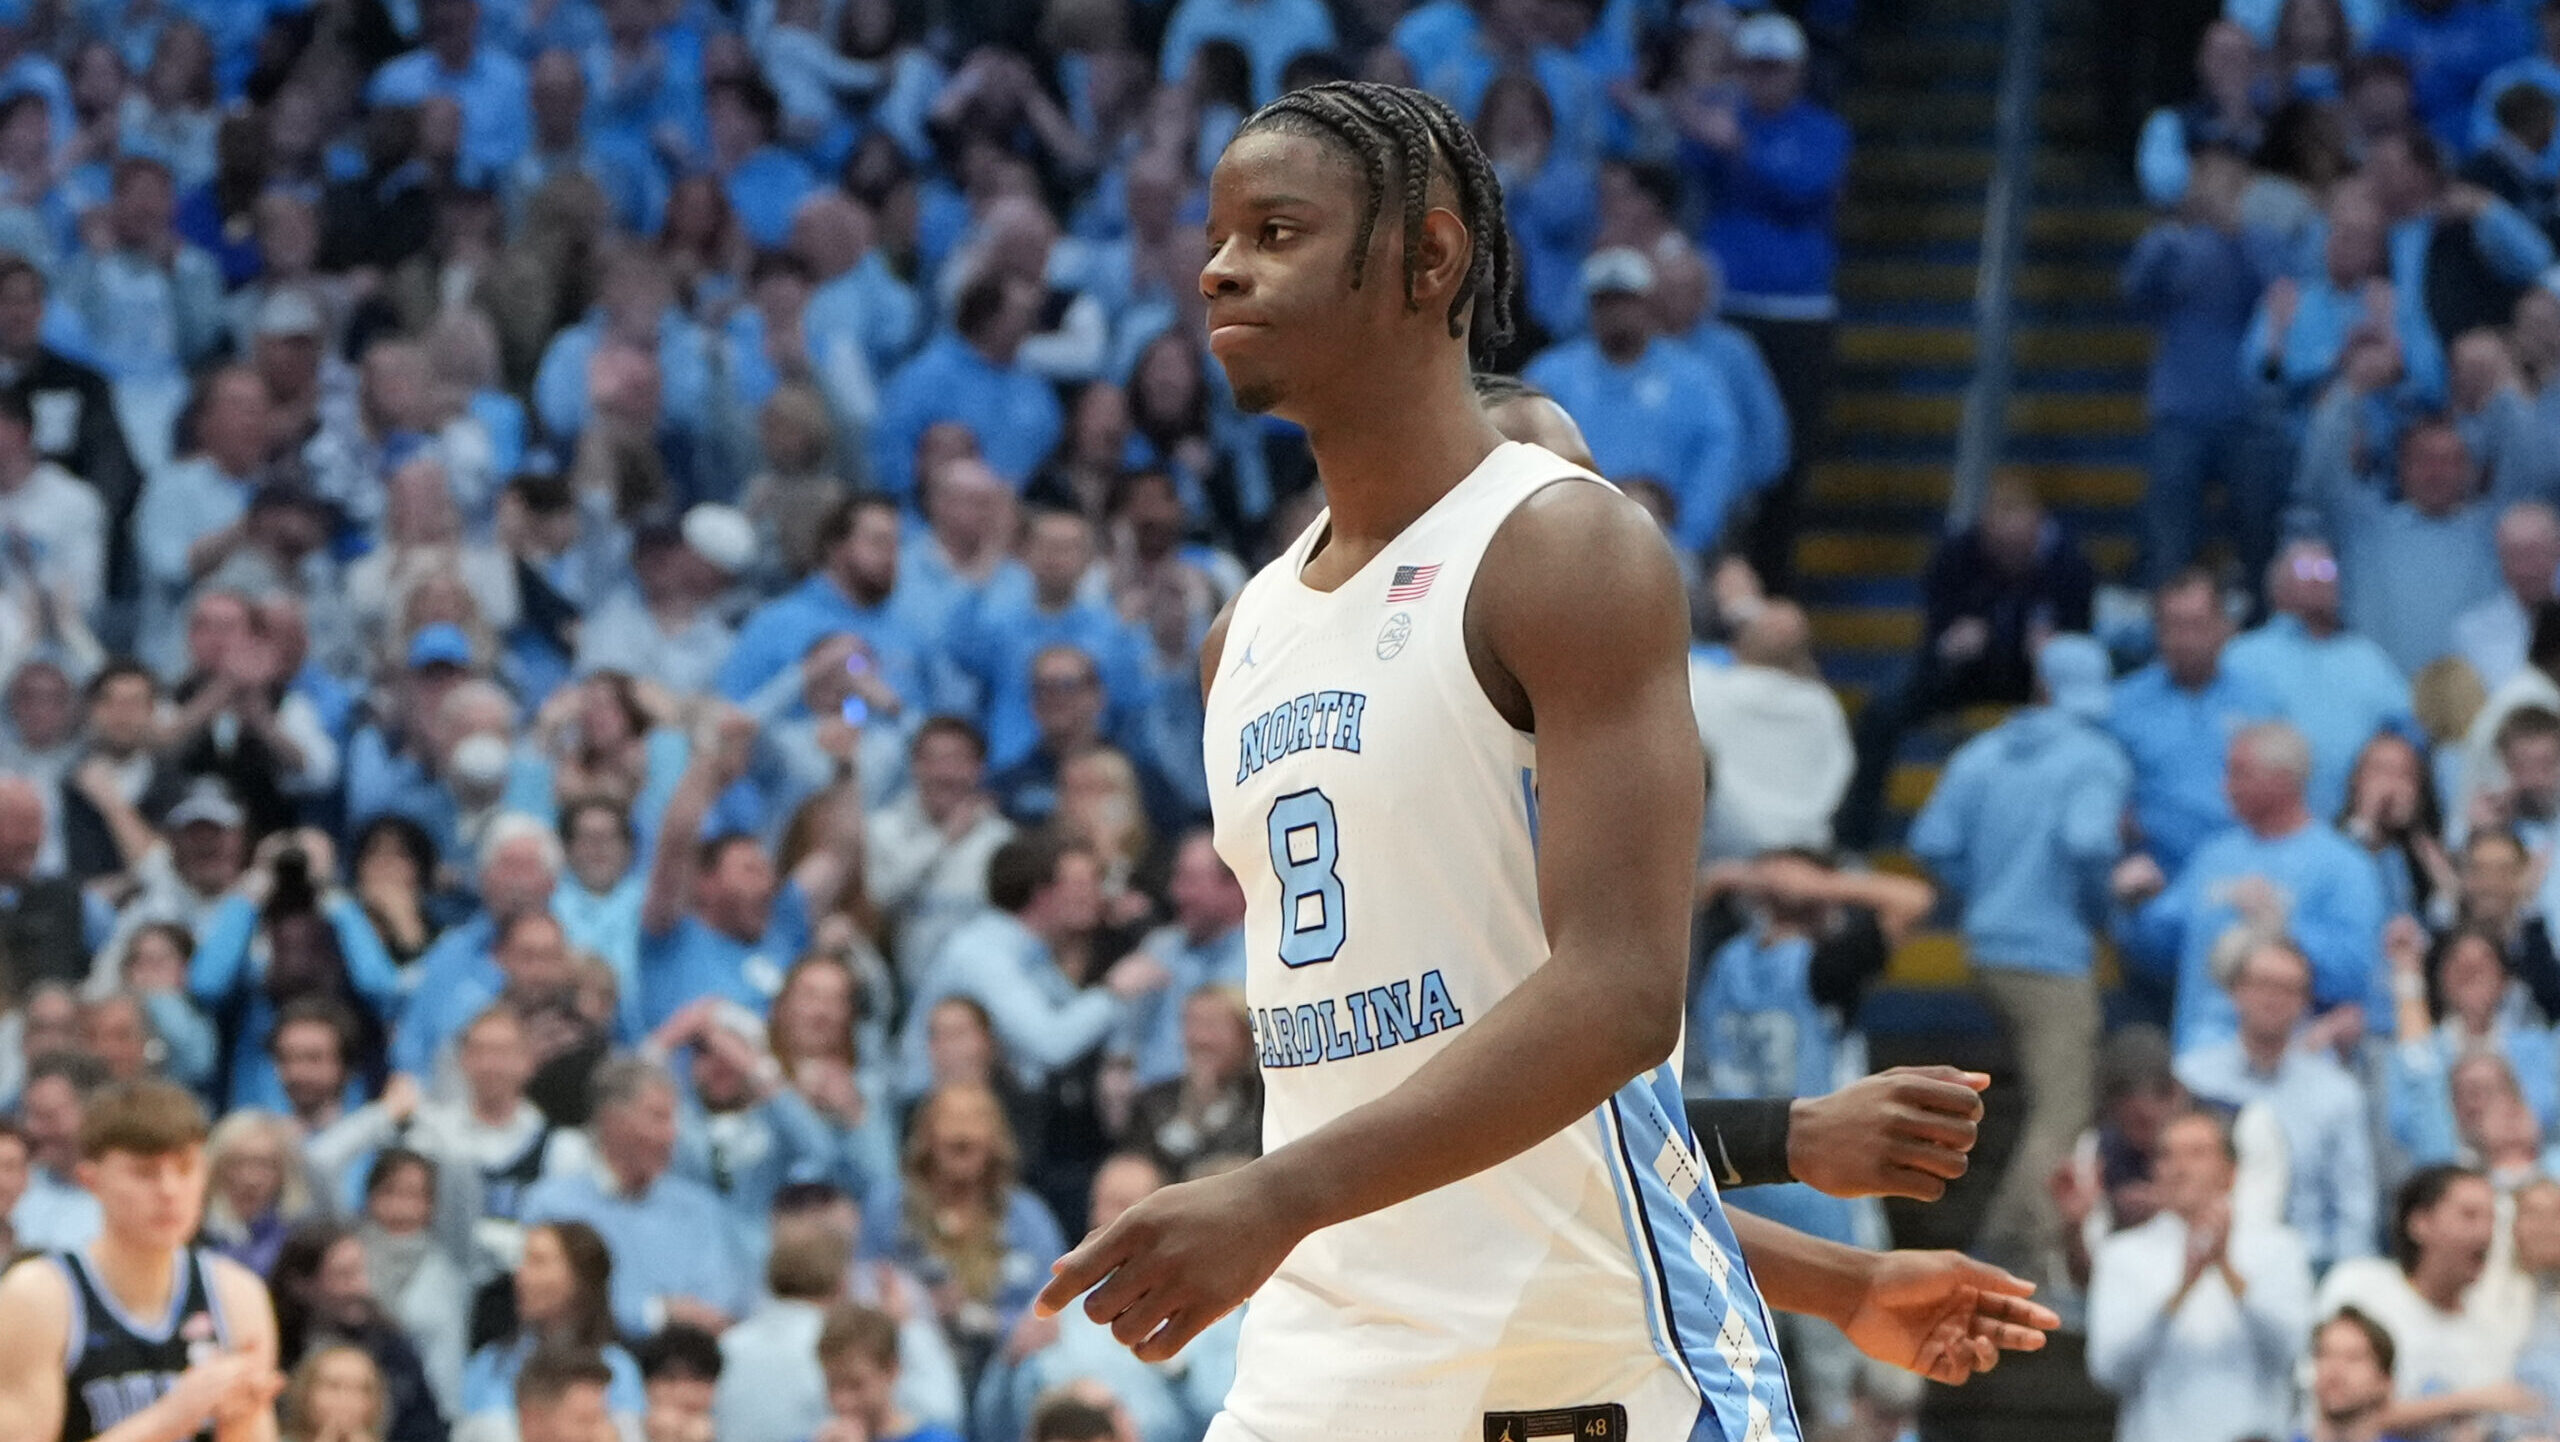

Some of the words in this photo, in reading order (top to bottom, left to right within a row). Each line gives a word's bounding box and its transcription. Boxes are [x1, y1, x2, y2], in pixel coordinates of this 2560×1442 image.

[1236, 690, 1367, 786] NORTH
[1267, 786, 1346, 969] 8
[1584, 1418, 1607, 1437] 48
